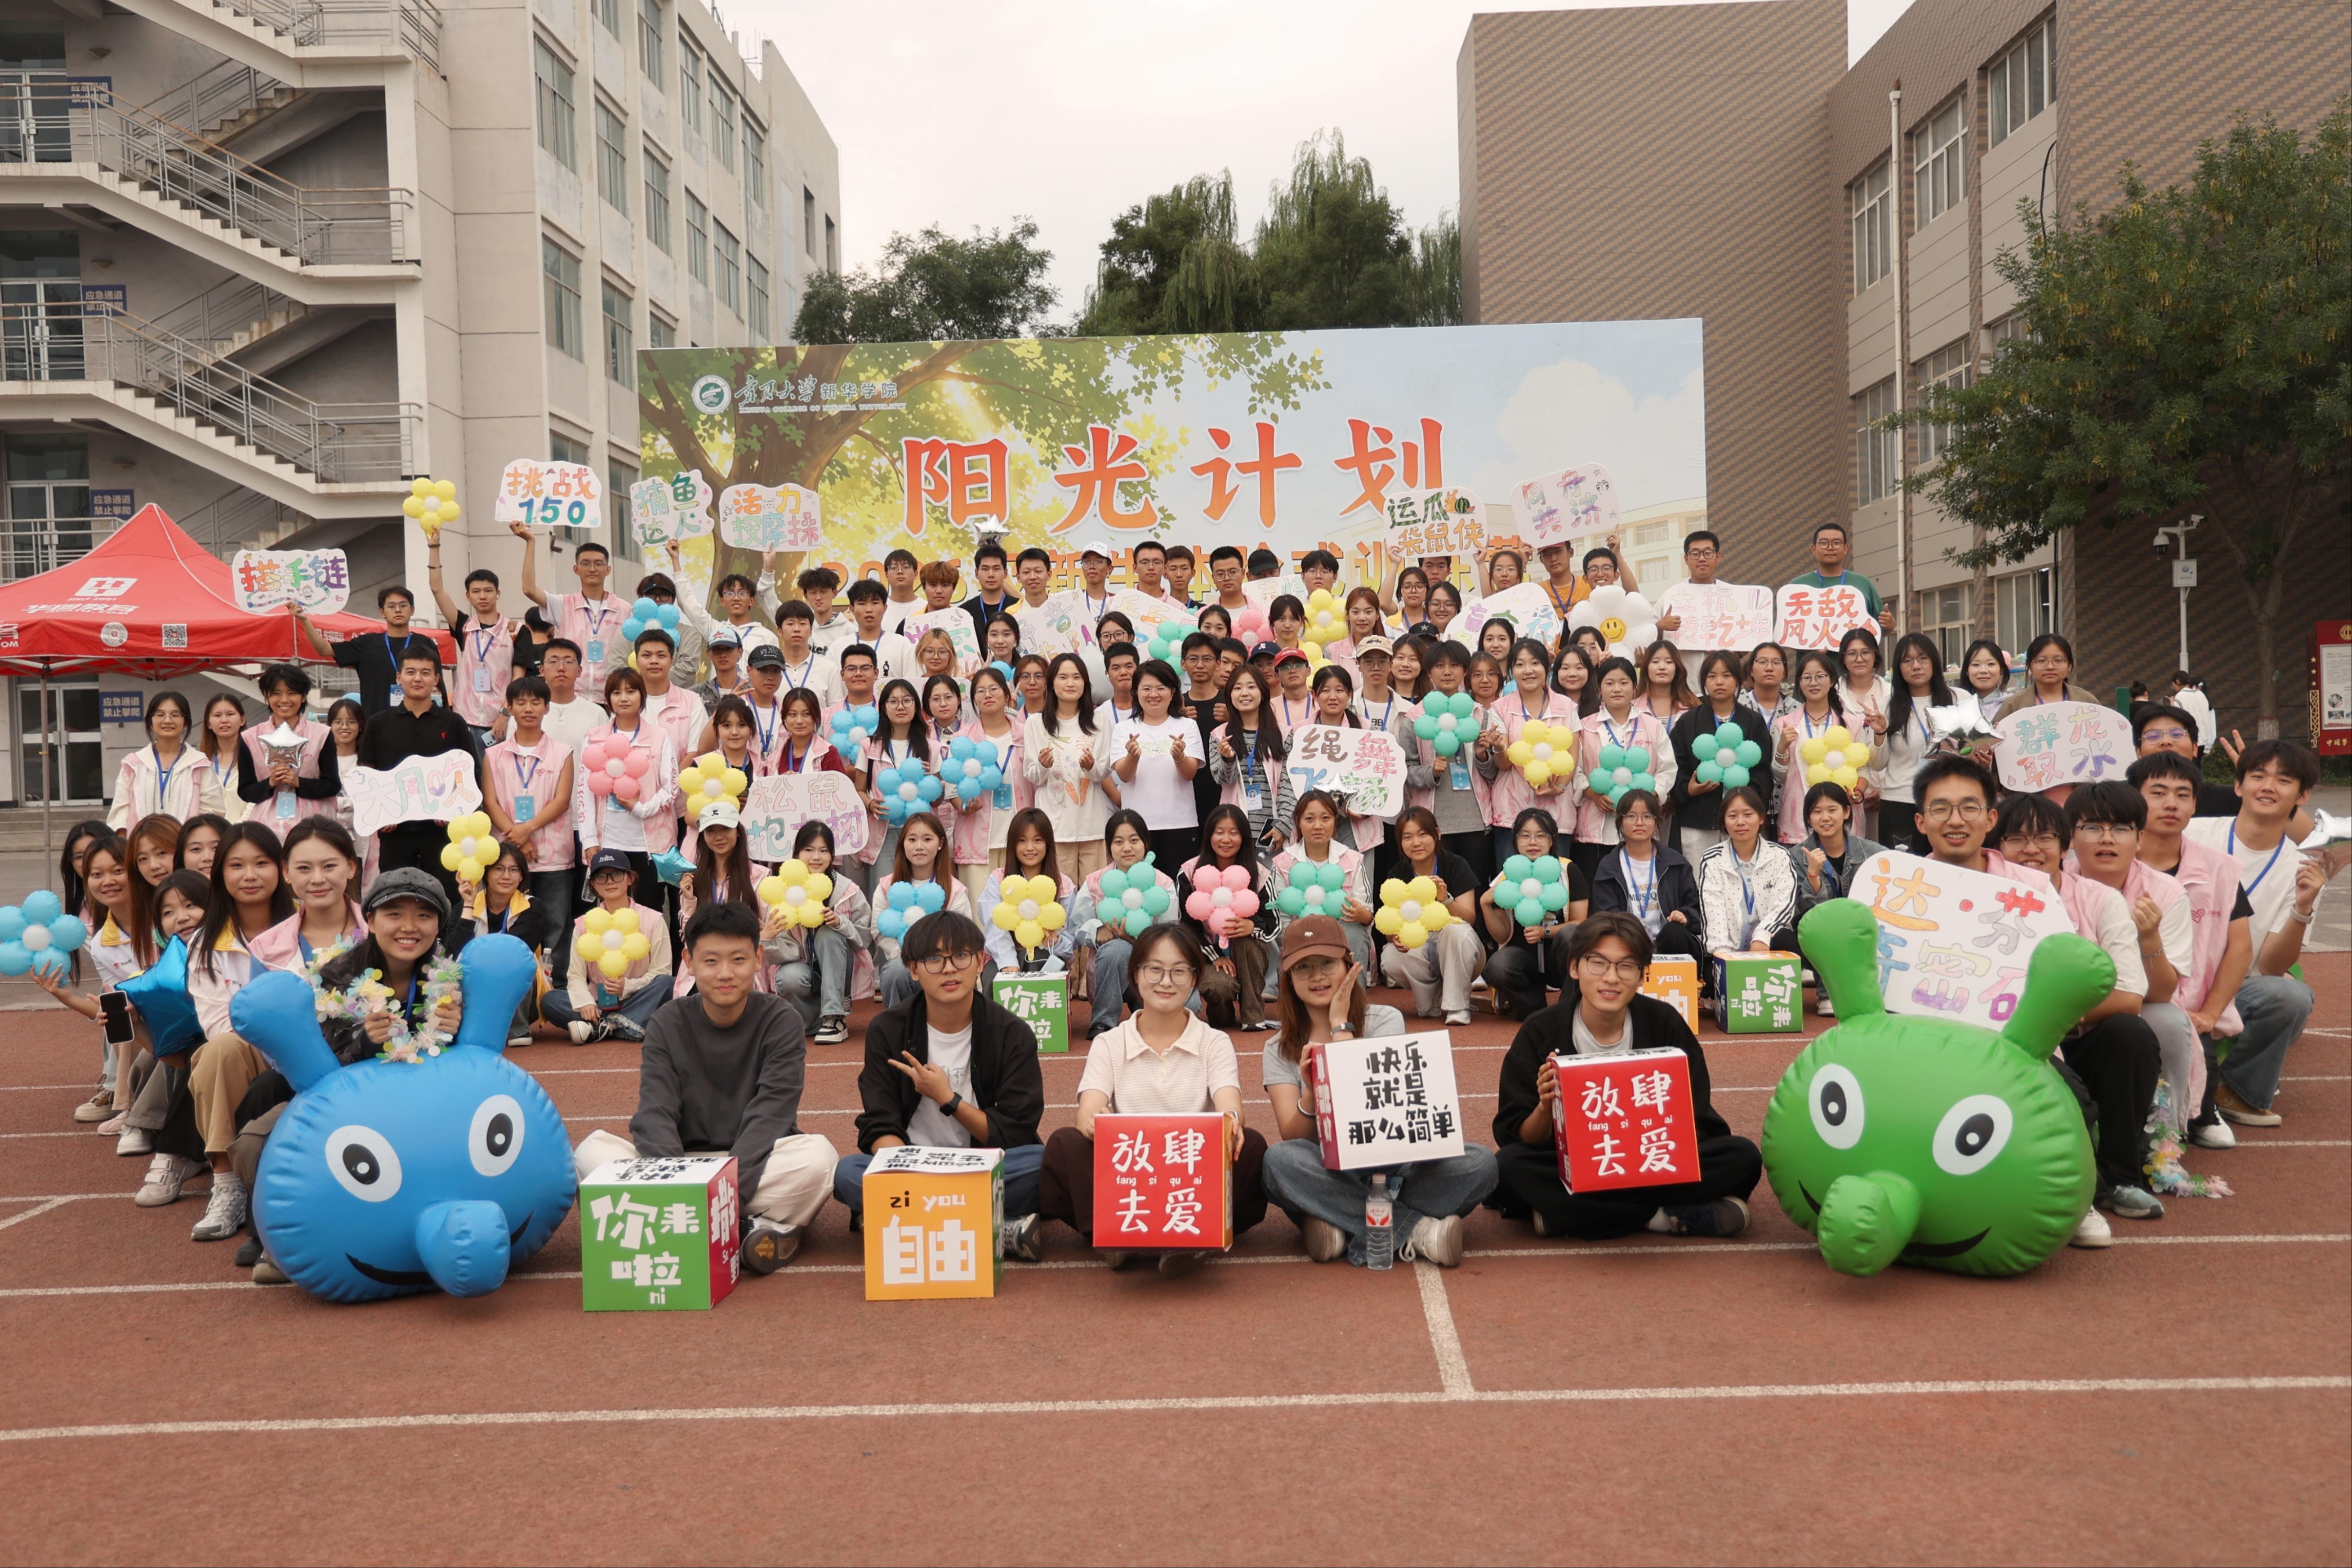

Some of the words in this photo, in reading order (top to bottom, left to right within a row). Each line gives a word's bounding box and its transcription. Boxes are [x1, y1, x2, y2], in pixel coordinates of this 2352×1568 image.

[506, 466, 596, 499] 挑战
[634, 473, 699, 517] 捕鱼
[902, 417, 1443, 537] 阳光计划
[1521, 470, 1586, 511] 同舟
[94, 495, 131, 504] 应急通道
[519, 499, 585, 525] 150
[733, 486, 801, 514] 活力
[1387, 491, 1450, 528] 运瓜
[640, 511, 700, 547] 达人
[732, 512, 820, 547] 按摩操
[1397, 518, 1485, 556] 袋鼠侠
[1534, 498, 1602, 540] 共济
[239, 555, 347, 592] 搭手链
[1672, 588, 1737, 614] 立棍
[1785, 589, 1859, 618] 无敌
[1669, 613, 1771, 646] 转乾坤
[103, 697, 140, 706] 应急通道
[2015, 706, 2108, 755] 群龙
[1302, 727, 1398, 779] 绳舞
[2017, 740, 2117, 787] 取水
[354, 758, 476, 826] 大风吹
[752, 774, 847, 812] 松鼠
[1629, 892, 1658, 901] MUSQ
[1657, 974, 1681, 985] you
[999, 984, 1063, 1018] 你来
[1366, 1040, 1427, 1075] 快乐
[1363, 1072, 1428, 1110] 就是
[1581, 1070, 1672, 1119] 放肆
[1348, 1104, 1455, 1145] 那么简单
[1588, 1122, 1609, 1131] fang
[1620, 1119, 1629, 1128] si
[1641, 1118, 1652, 1128] qu
[1664, 1115, 1673, 1124] ai
[1111, 1128, 1205, 1175] 放肆
[1591, 1127, 1677, 1176] 去爱
[1115, 1175, 1137, 1186] fang
[1148, 1175, 1157, 1185] si
[1169, 1176, 1181, 1187] qu
[1193, 1175, 1202, 1185] ai
[890, 1190, 910, 1208] zi
[922, 1194, 966, 1212] you
[1115, 1188, 1203, 1235] 去爱
[590, 1191, 700, 1250] 你来
[883, 1214, 976, 1284] 自由
[611, 1251, 681, 1286] 啦
[650, 1286, 666, 1305] ni
